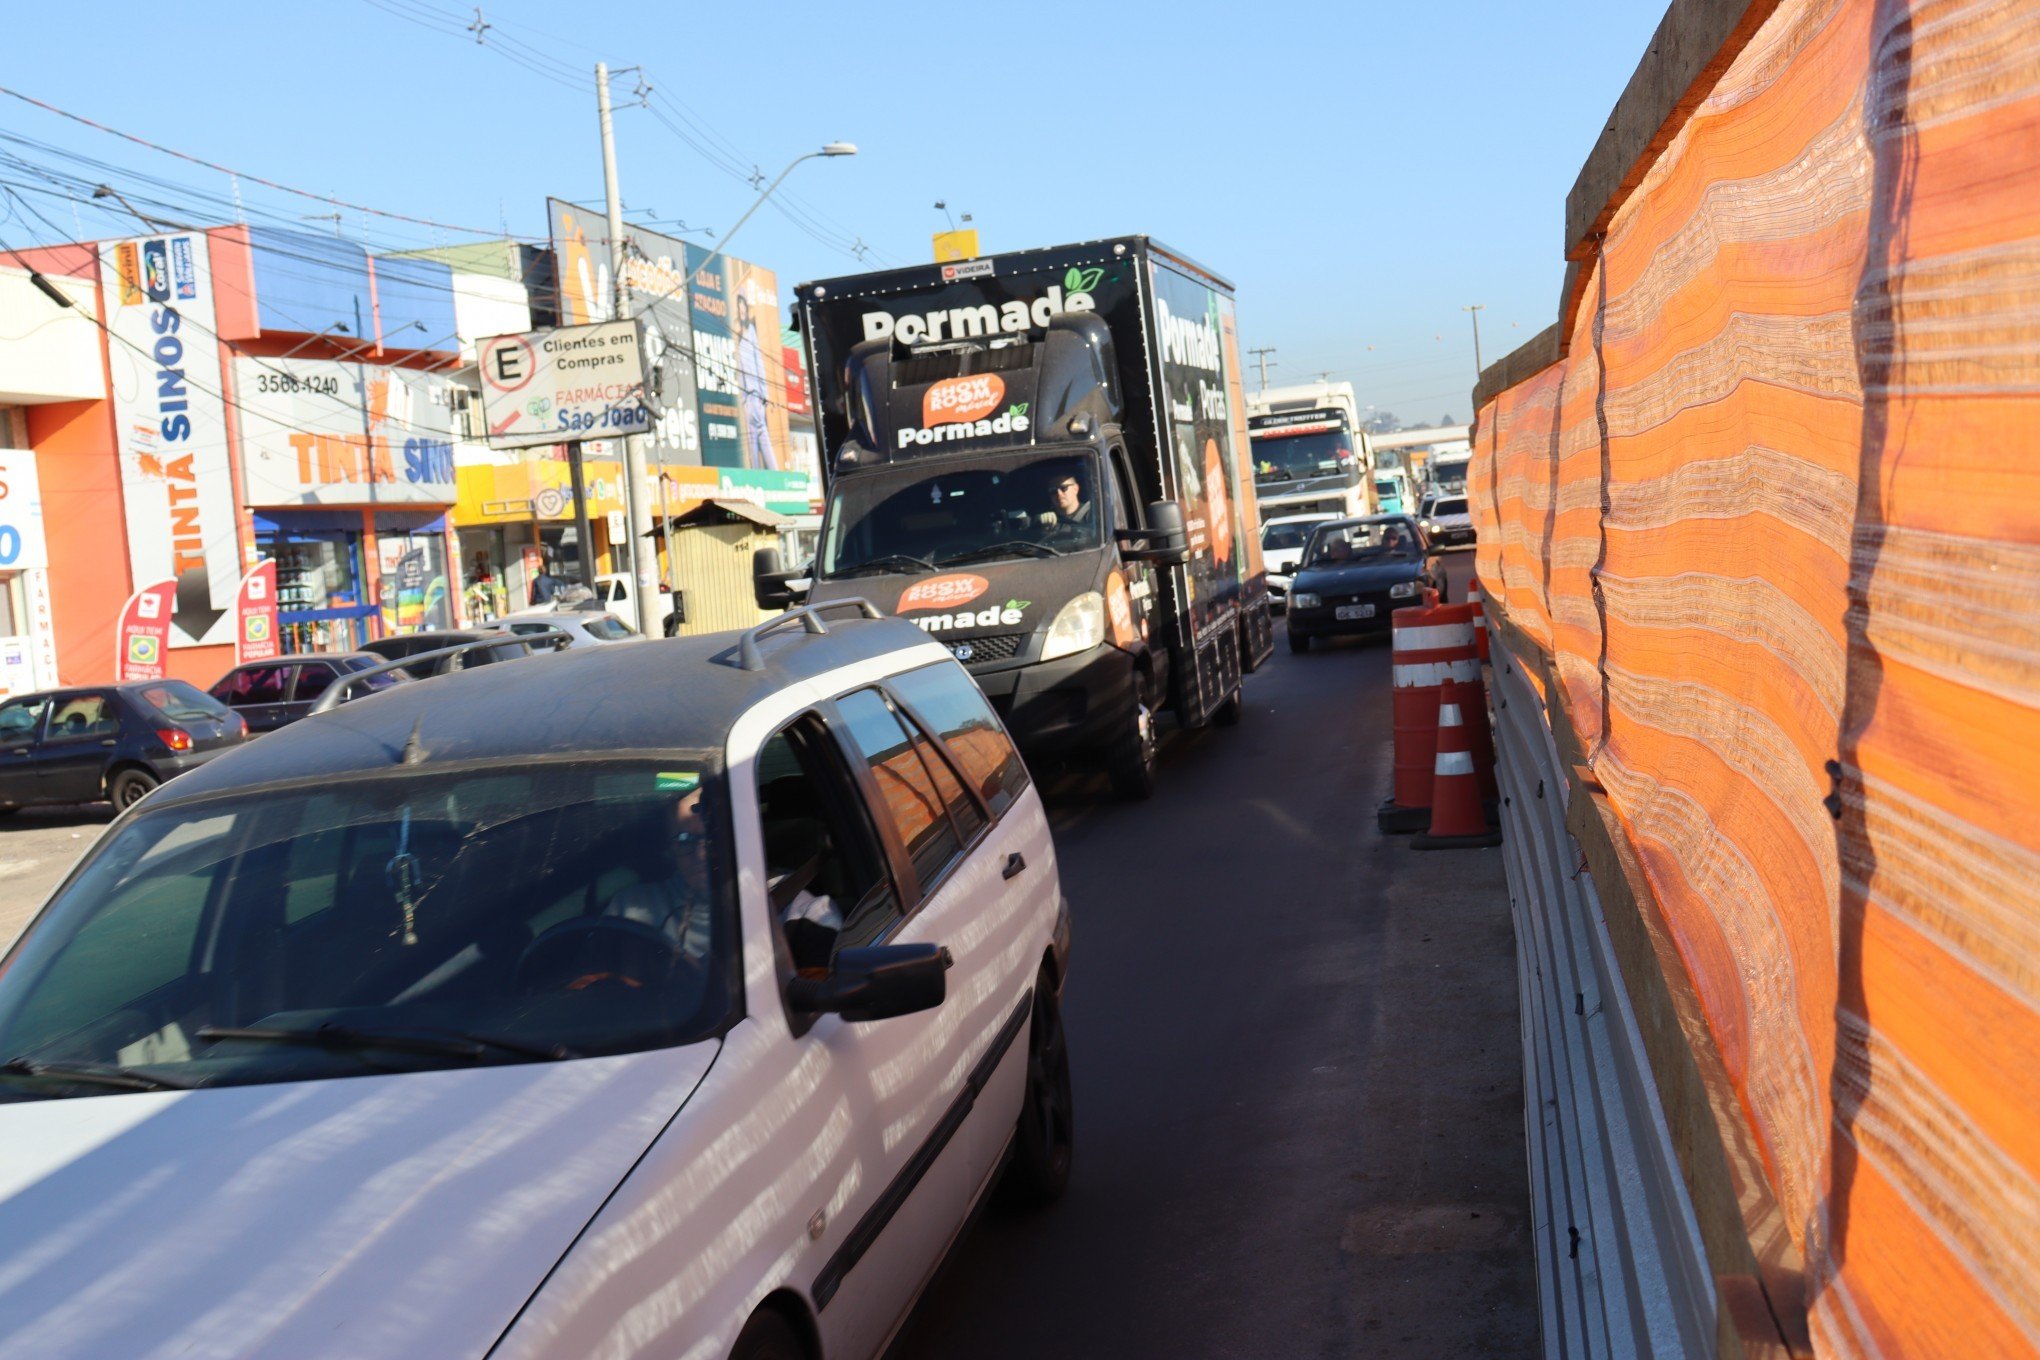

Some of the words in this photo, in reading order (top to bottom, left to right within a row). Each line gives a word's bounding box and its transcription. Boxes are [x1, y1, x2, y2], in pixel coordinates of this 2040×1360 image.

[152, 251, 167, 292] Coral
[956, 264, 990, 275] VIDEIRA
[861, 286, 1096, 345] Pormade
[543, 335, 606, 353] Clientes
[610, 332, 634, 346] em
[1157, 298, 1220, 372] Pormade
[151, 307, 191, 442] SINOS
[496, 346, 522, 380] E
[556, 354, 625, 371] Compras
[555, 382, 645, 406] FARMÁCIAS
[930, 387, 991, 412] ROOM
[931, 377, 991, 396] SHOW
[557, 406, 595, 433] São
[601, 399, 648, 428] João
[898, 411, 1030, 449] Pormade
[289, 432, 397, 485] TINTA
[166, 452, 206, 577] TINTA
